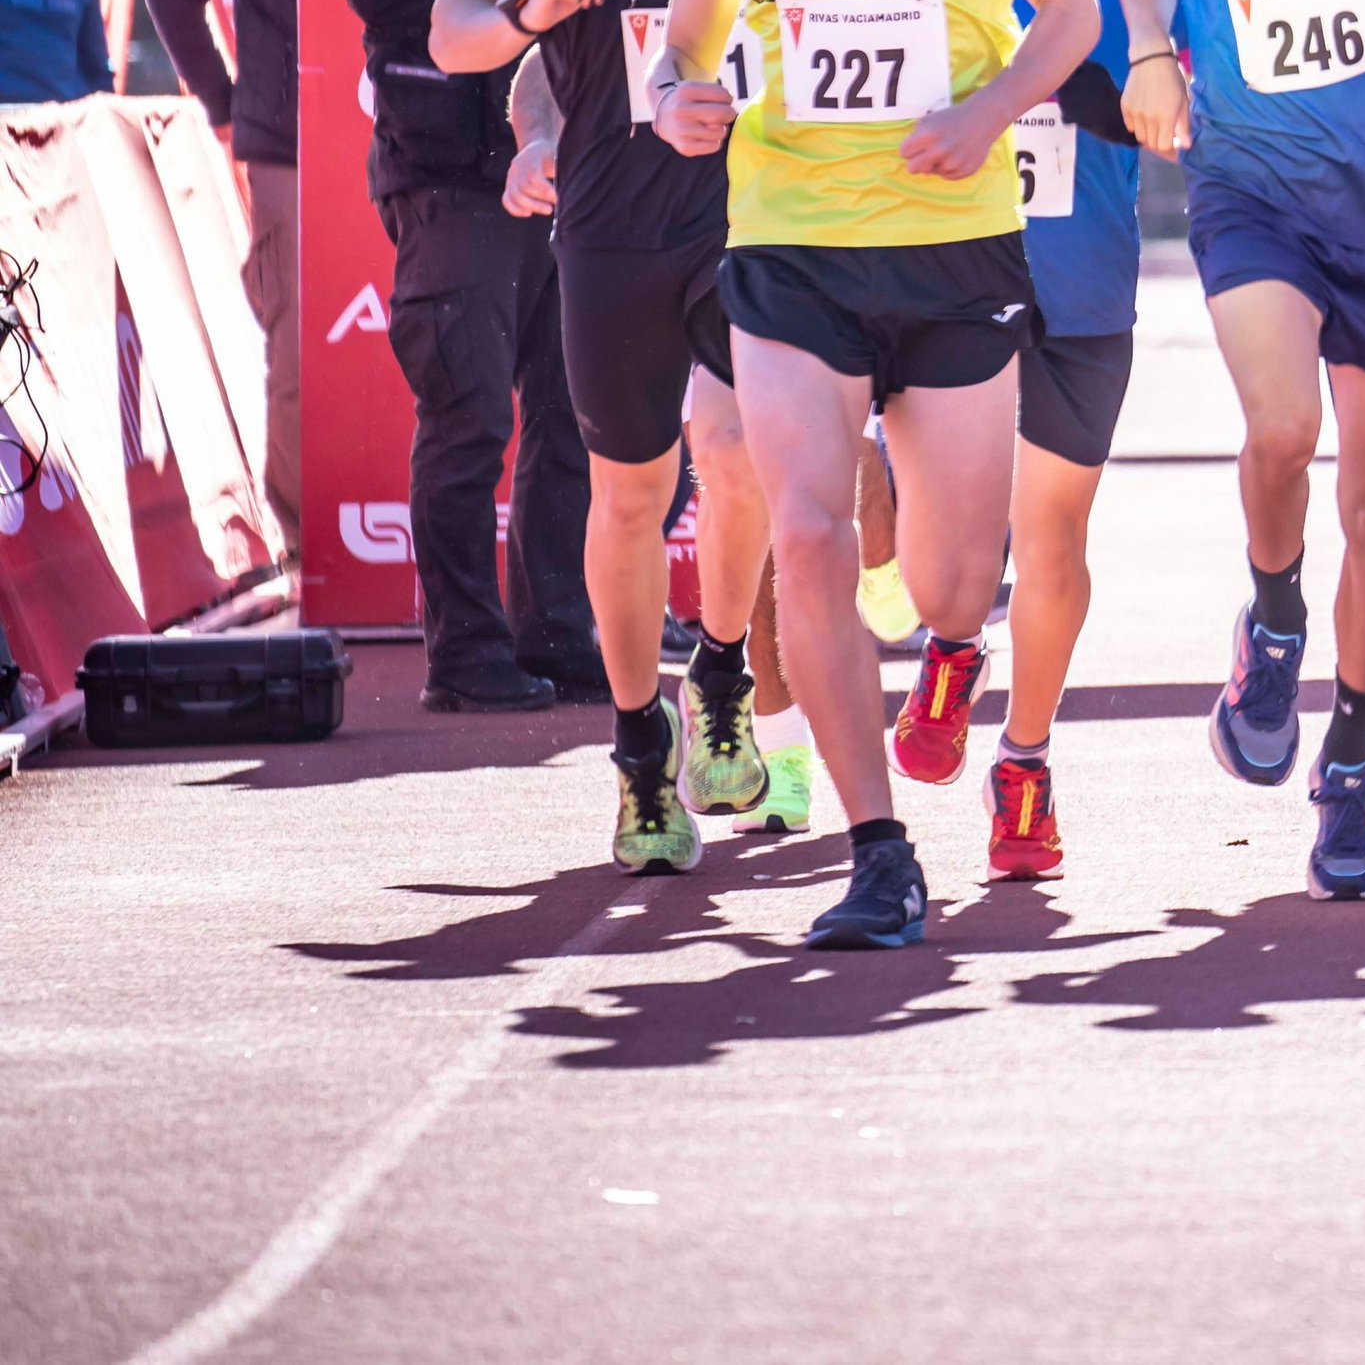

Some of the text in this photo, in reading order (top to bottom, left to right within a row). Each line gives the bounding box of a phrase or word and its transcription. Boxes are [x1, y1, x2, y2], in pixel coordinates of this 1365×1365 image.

[808, 10, 922, 24] RIVAS VACIAMADRID
[1267, 10, 1364, 77] 246
[717, 43, 749, 100] 1
[811, 48, 905, 109] 227
